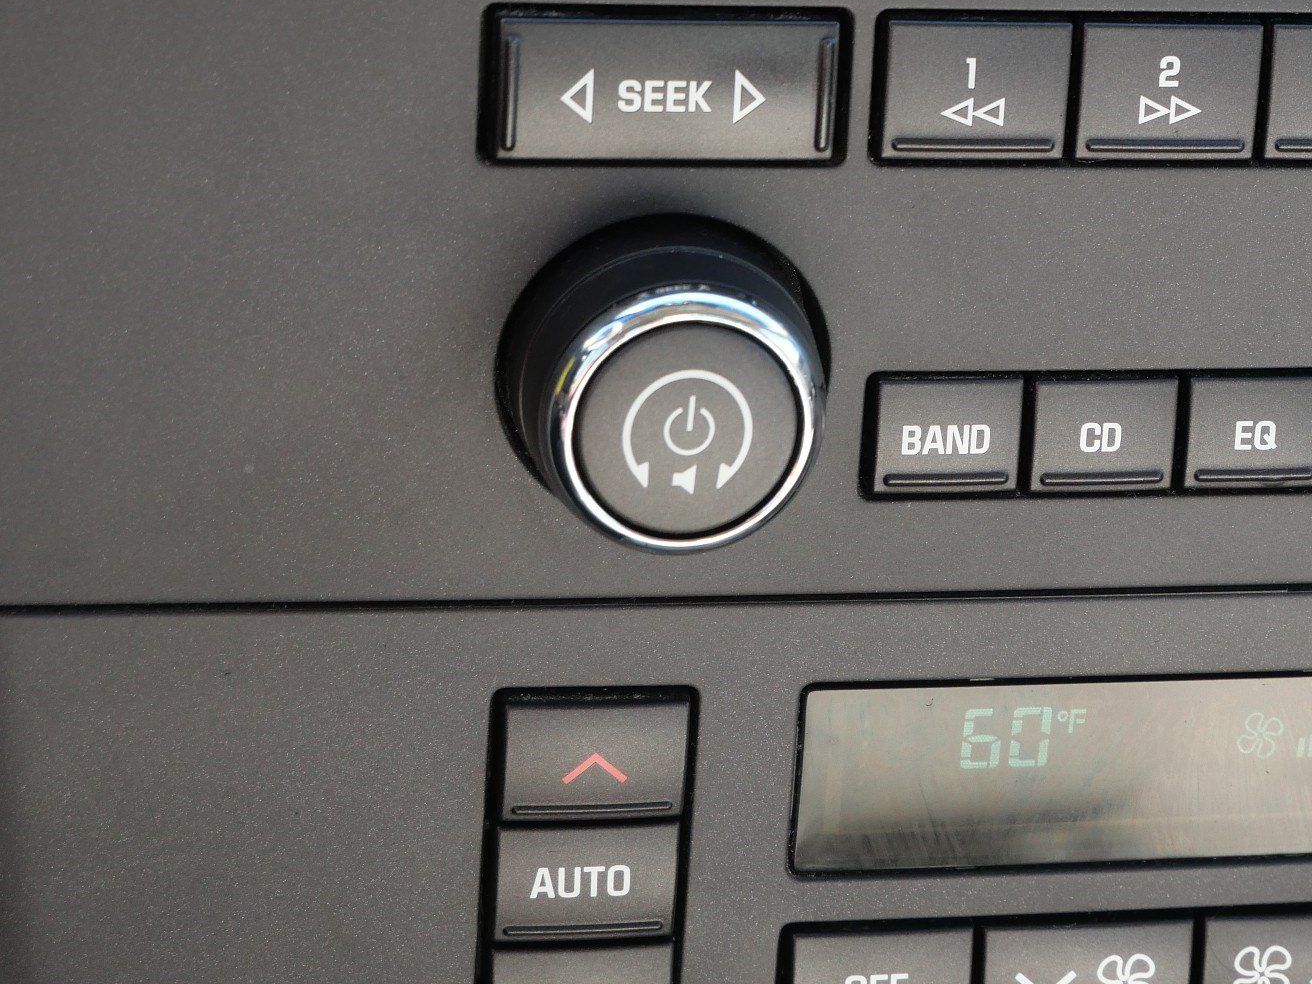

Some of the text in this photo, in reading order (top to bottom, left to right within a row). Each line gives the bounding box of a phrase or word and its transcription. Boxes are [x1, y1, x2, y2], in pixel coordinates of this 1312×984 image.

[965, 57, 977, 90] 1
[1158, 55, 1181, 88] 2
[617, 79, 713, 113] SEEK
[900, 424, 991, 456] BAND
[1079, 422, 1122, 453] CD
[1233, 420, 1278, 452] EQ
[529, 864, 631, 899] AUTO
